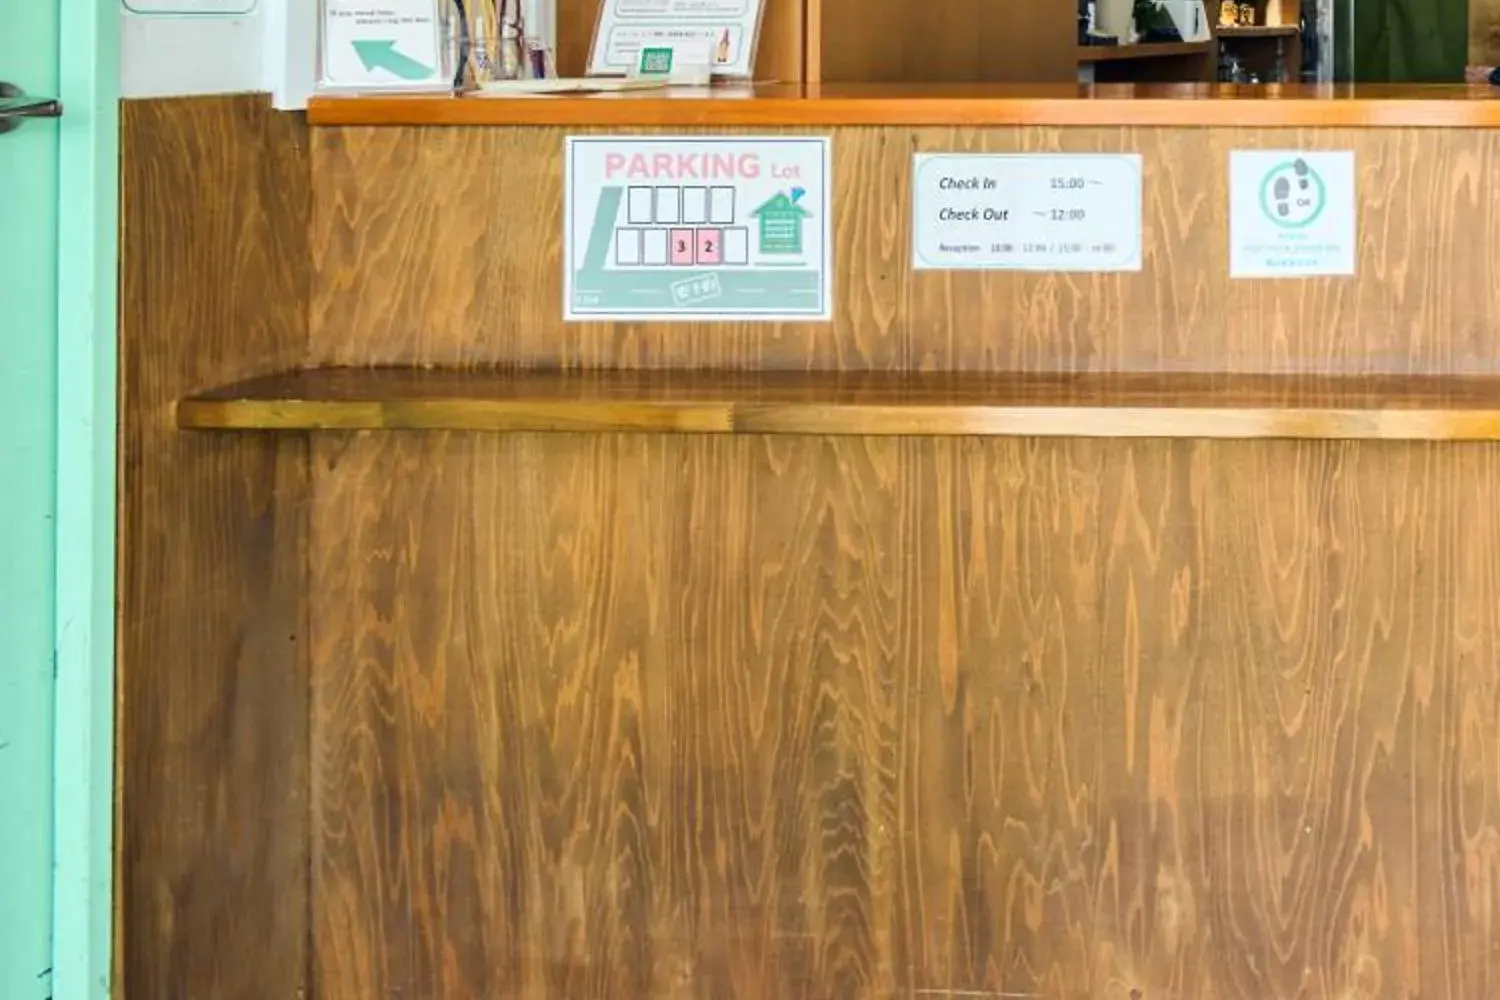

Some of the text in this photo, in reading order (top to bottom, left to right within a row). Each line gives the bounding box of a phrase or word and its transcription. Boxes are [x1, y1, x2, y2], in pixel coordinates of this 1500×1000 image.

[604, 152, 802, 180] PARKING Lot
[938, 176, 980, 190] Check
[982, 176, 998, 190] In
[1050, 177, 1085, 190] 15:00
[938, 207, 980, 221] Check
[982, 207, 1010, 221] Out
[1050, 208, 1086, 221] 12:00
[677, 239, 714, 253] 3 2
